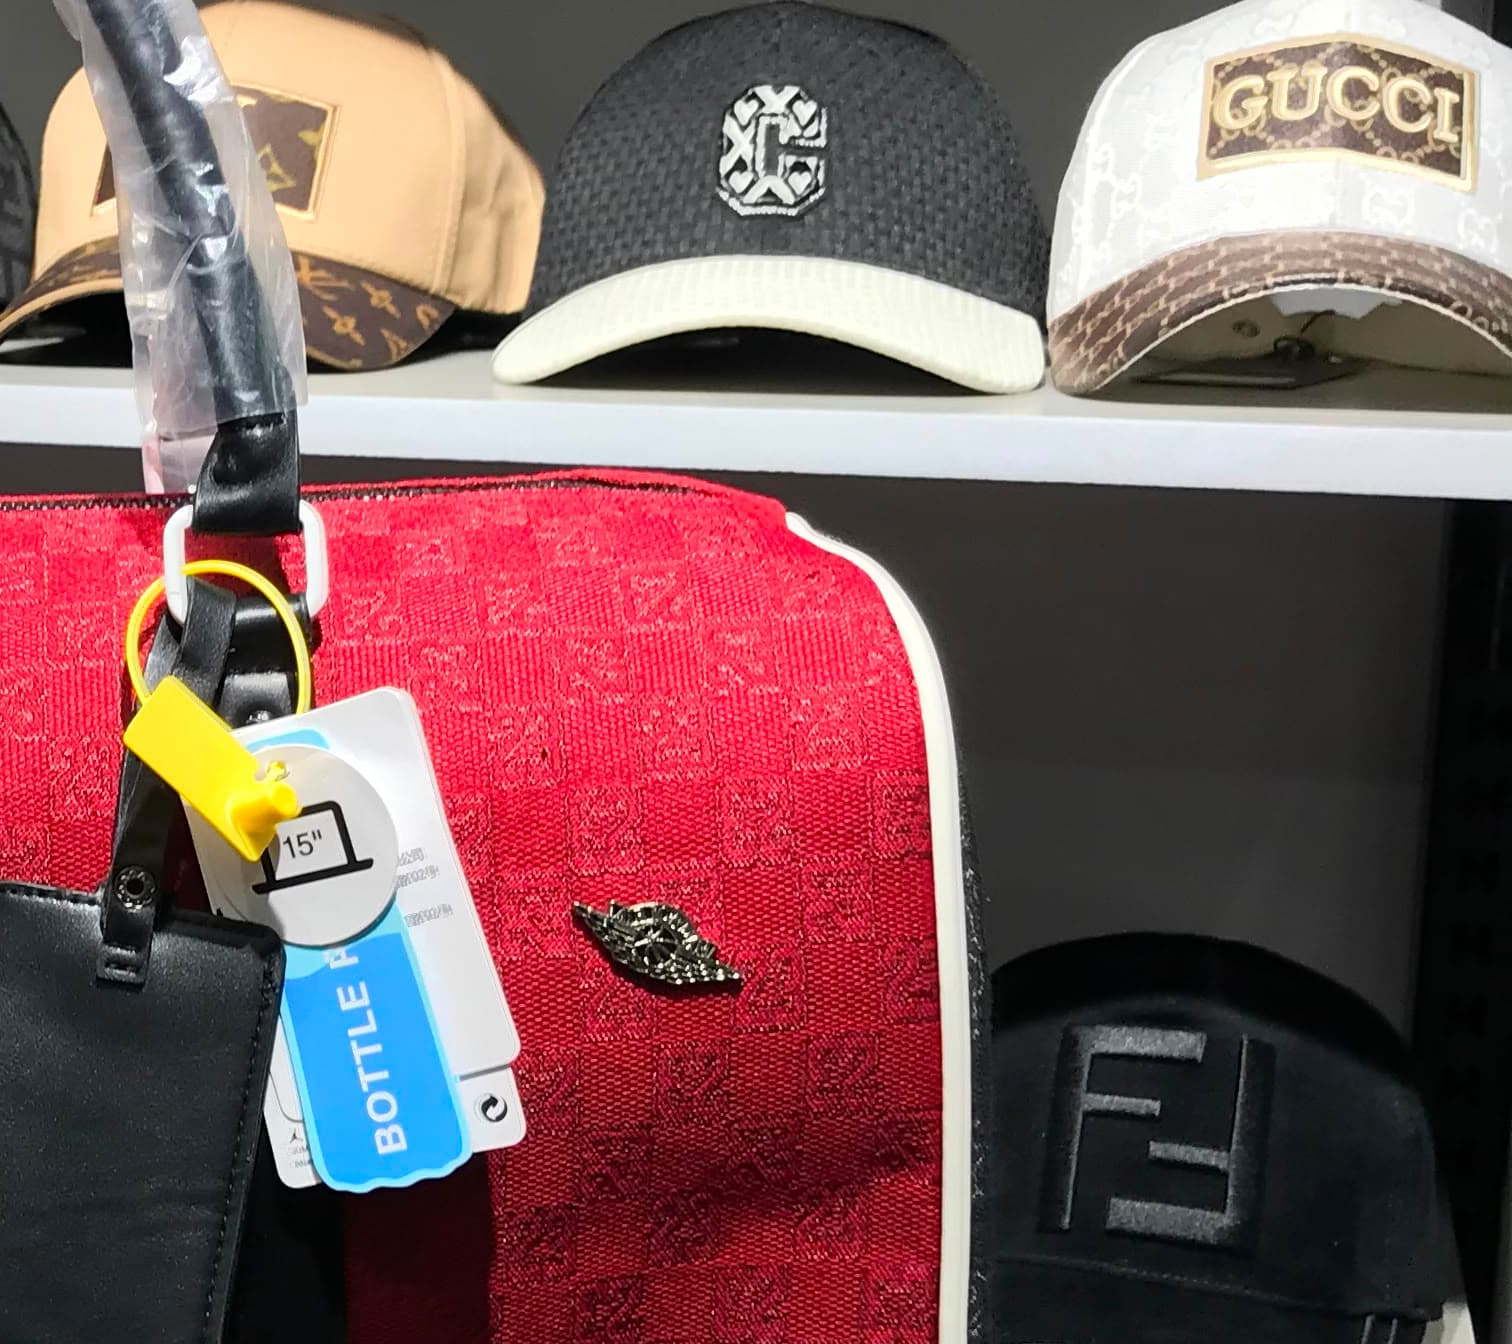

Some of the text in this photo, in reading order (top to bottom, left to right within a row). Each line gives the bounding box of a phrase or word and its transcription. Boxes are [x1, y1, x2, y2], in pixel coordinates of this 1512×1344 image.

[1212, 61, 1461, 144] GUCCI
[282, 828, 322, 859] 15"
[336, 980, 408, 1156] BOTTLE
